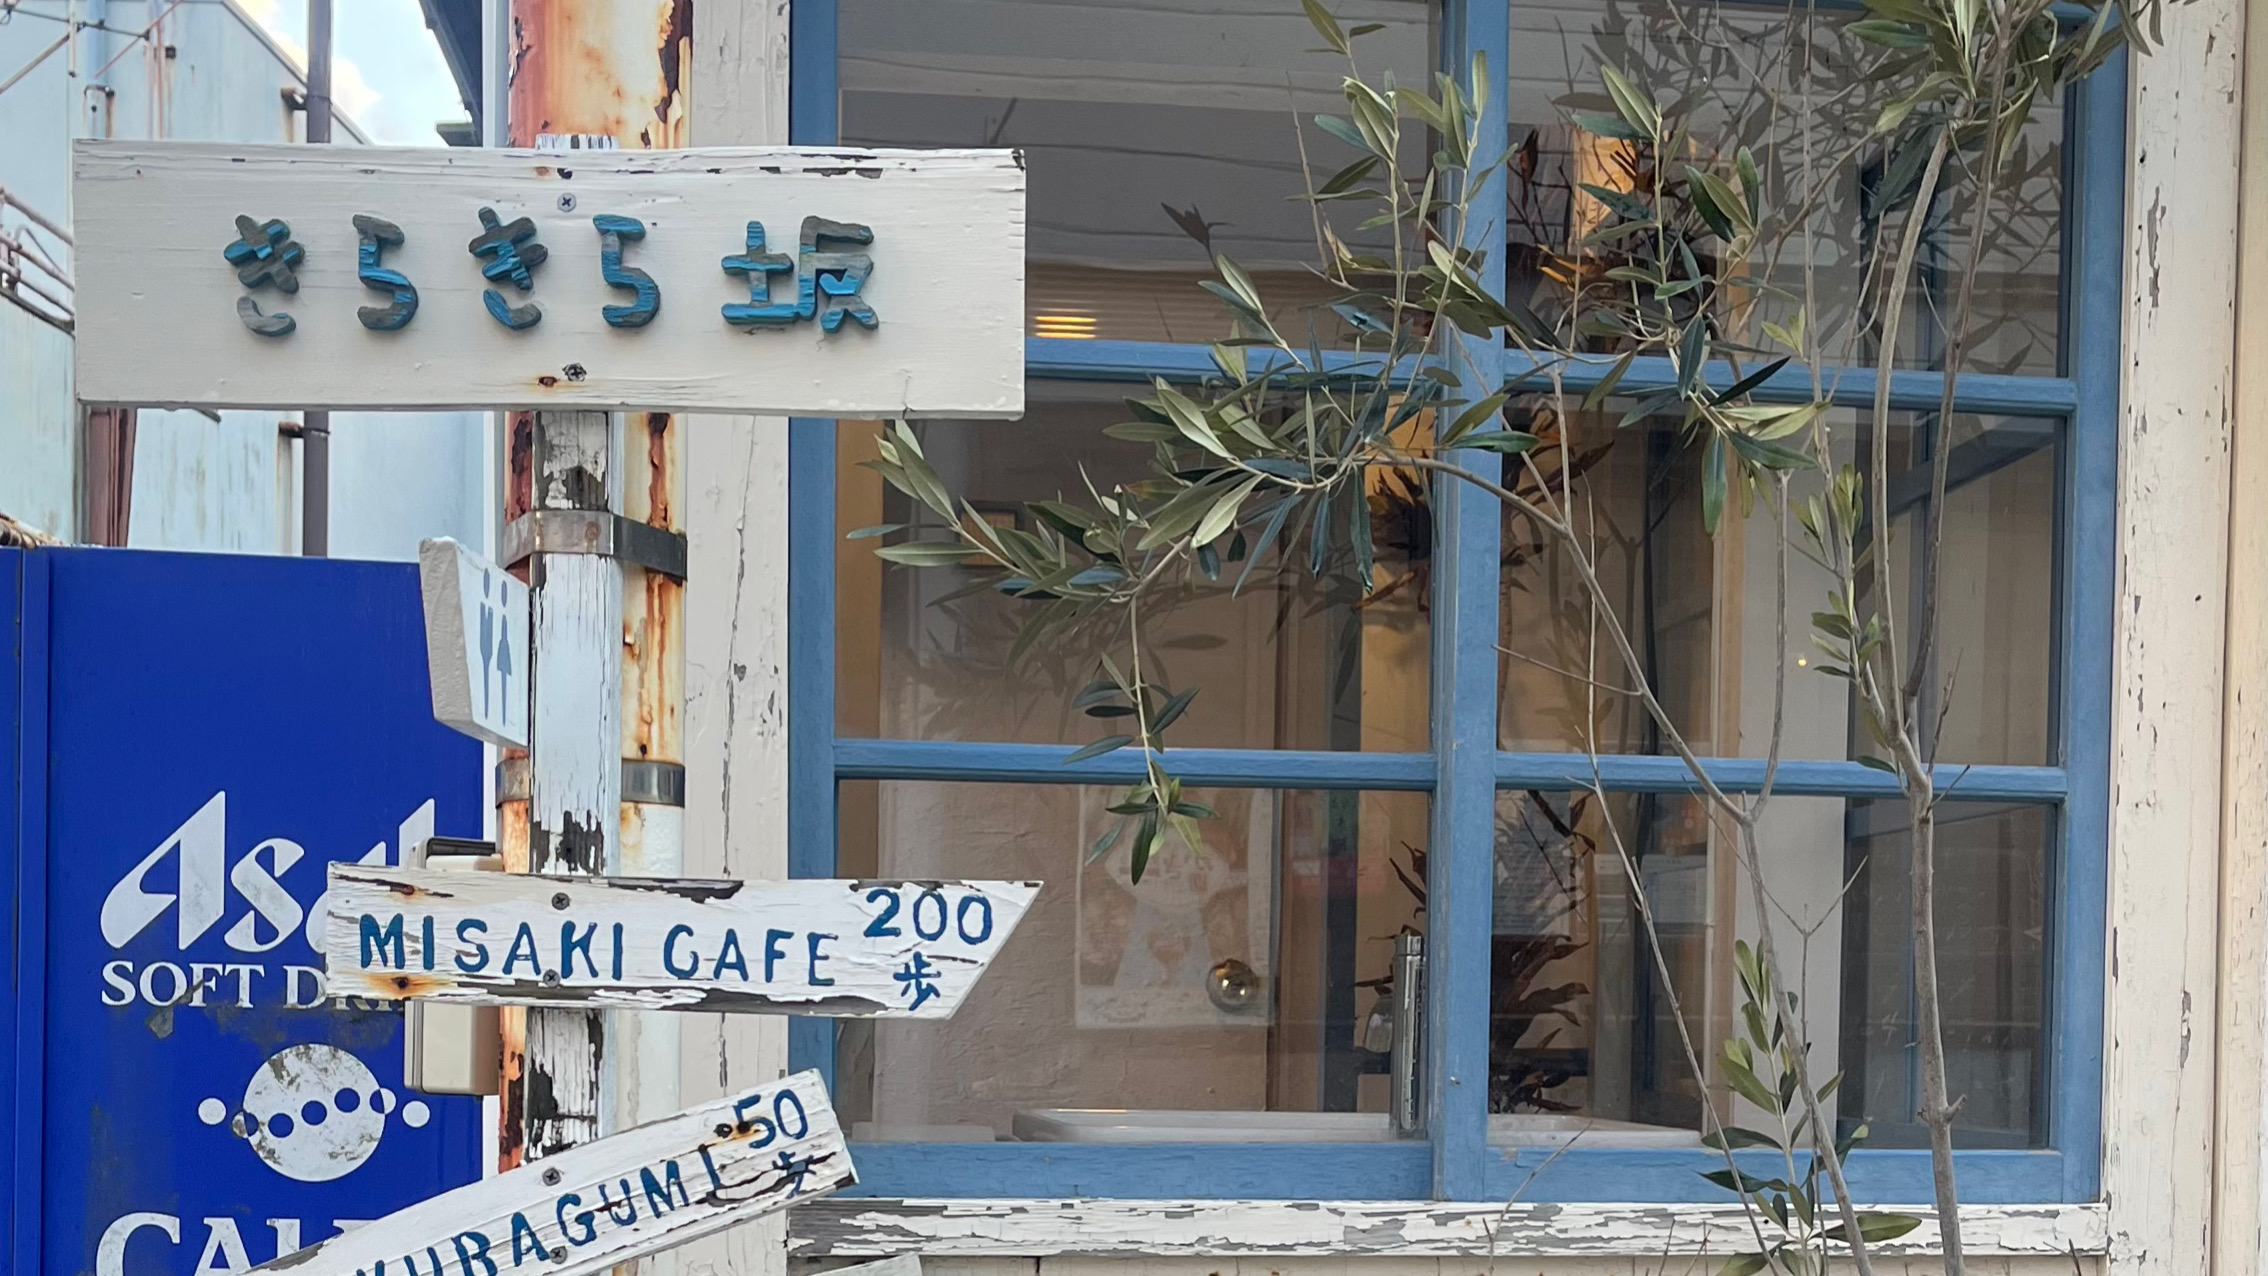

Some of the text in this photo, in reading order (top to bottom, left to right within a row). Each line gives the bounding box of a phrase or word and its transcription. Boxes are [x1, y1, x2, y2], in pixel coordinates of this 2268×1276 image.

[223, 205, 879, 336] きらきら坂
[863, 889, 992, 945] 200
[359, 913, 839, 986] MISAKI CAFE
[101, 960, 265, 1009] SOFT
[893, 951, 941, 1011] 歩
[733, 1088, 808, 1149] 50
[356, 1144, 721, 1276] URAGUMI
